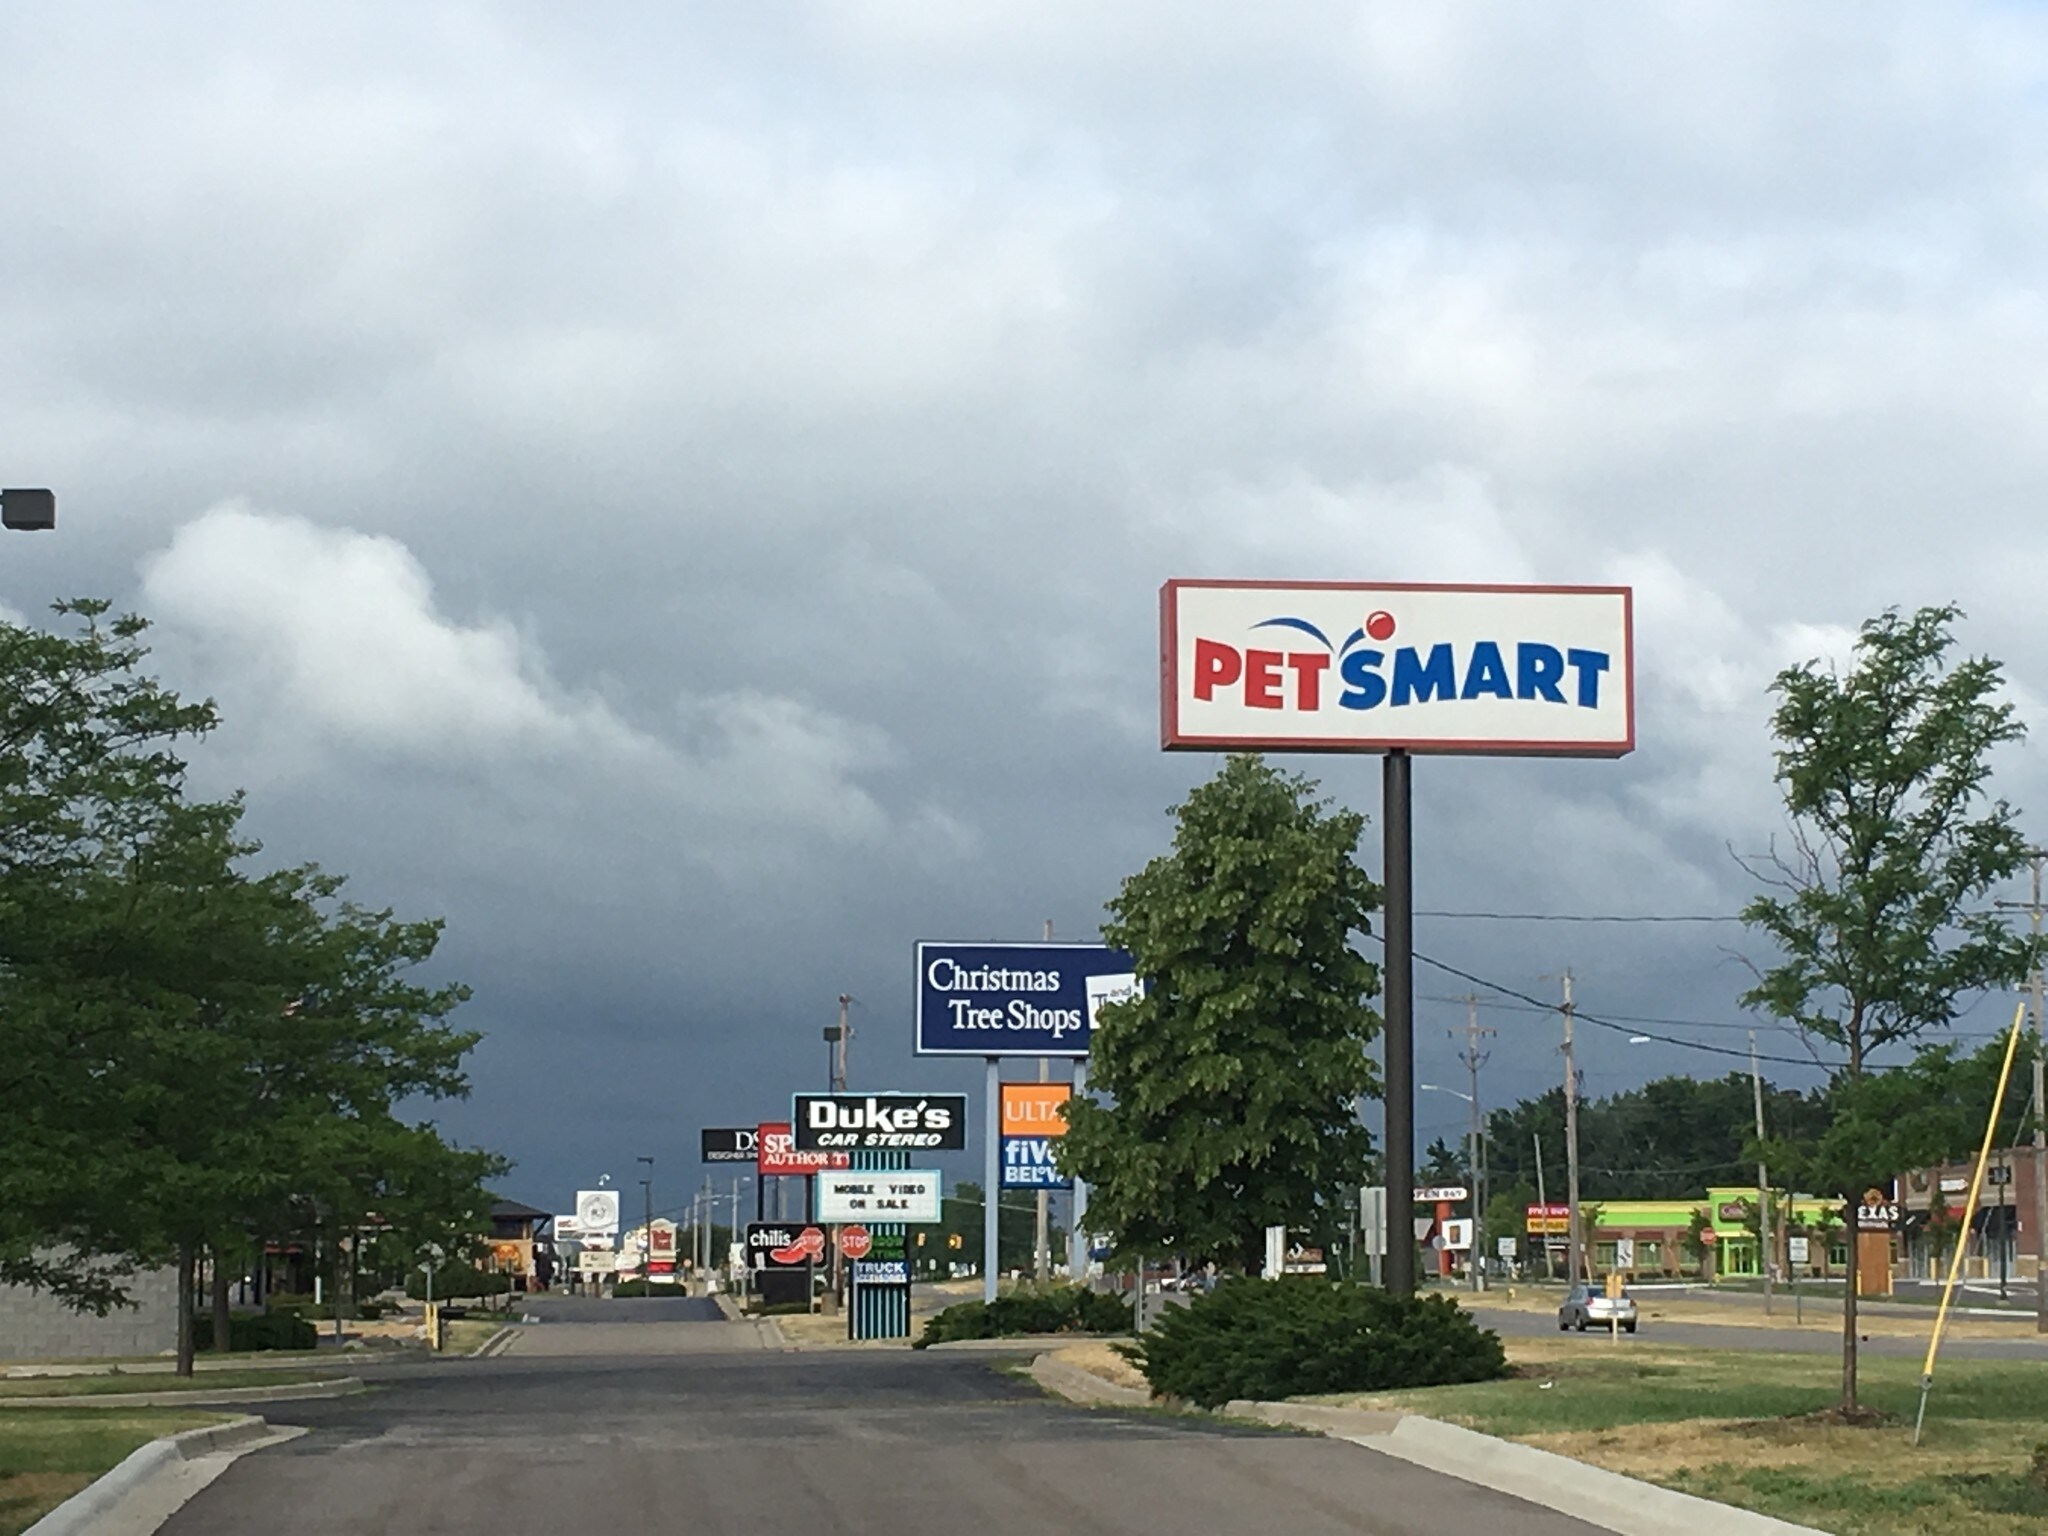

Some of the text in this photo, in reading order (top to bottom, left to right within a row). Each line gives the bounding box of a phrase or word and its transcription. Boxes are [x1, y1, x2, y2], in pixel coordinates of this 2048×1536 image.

[928, 958, 1060, 991] Christmas
[948, 999, 1081, 1038] Tree Shops
[809, 1098, 950, 1132] Duke's
[817, 1133, 942, 1146] CAR STEREO
[764, 1152, 850, 1165] AUTHORT
[834, 1185, 925, 1194] MOBILE VIDEO
[849, 1200, 908, 1209] ON SALE
[1857, 1205, 1899, 1220] EXAS
[843, 1236, 869, 1248] STOP
[858, 1262, 904, 1273] TRUCK
